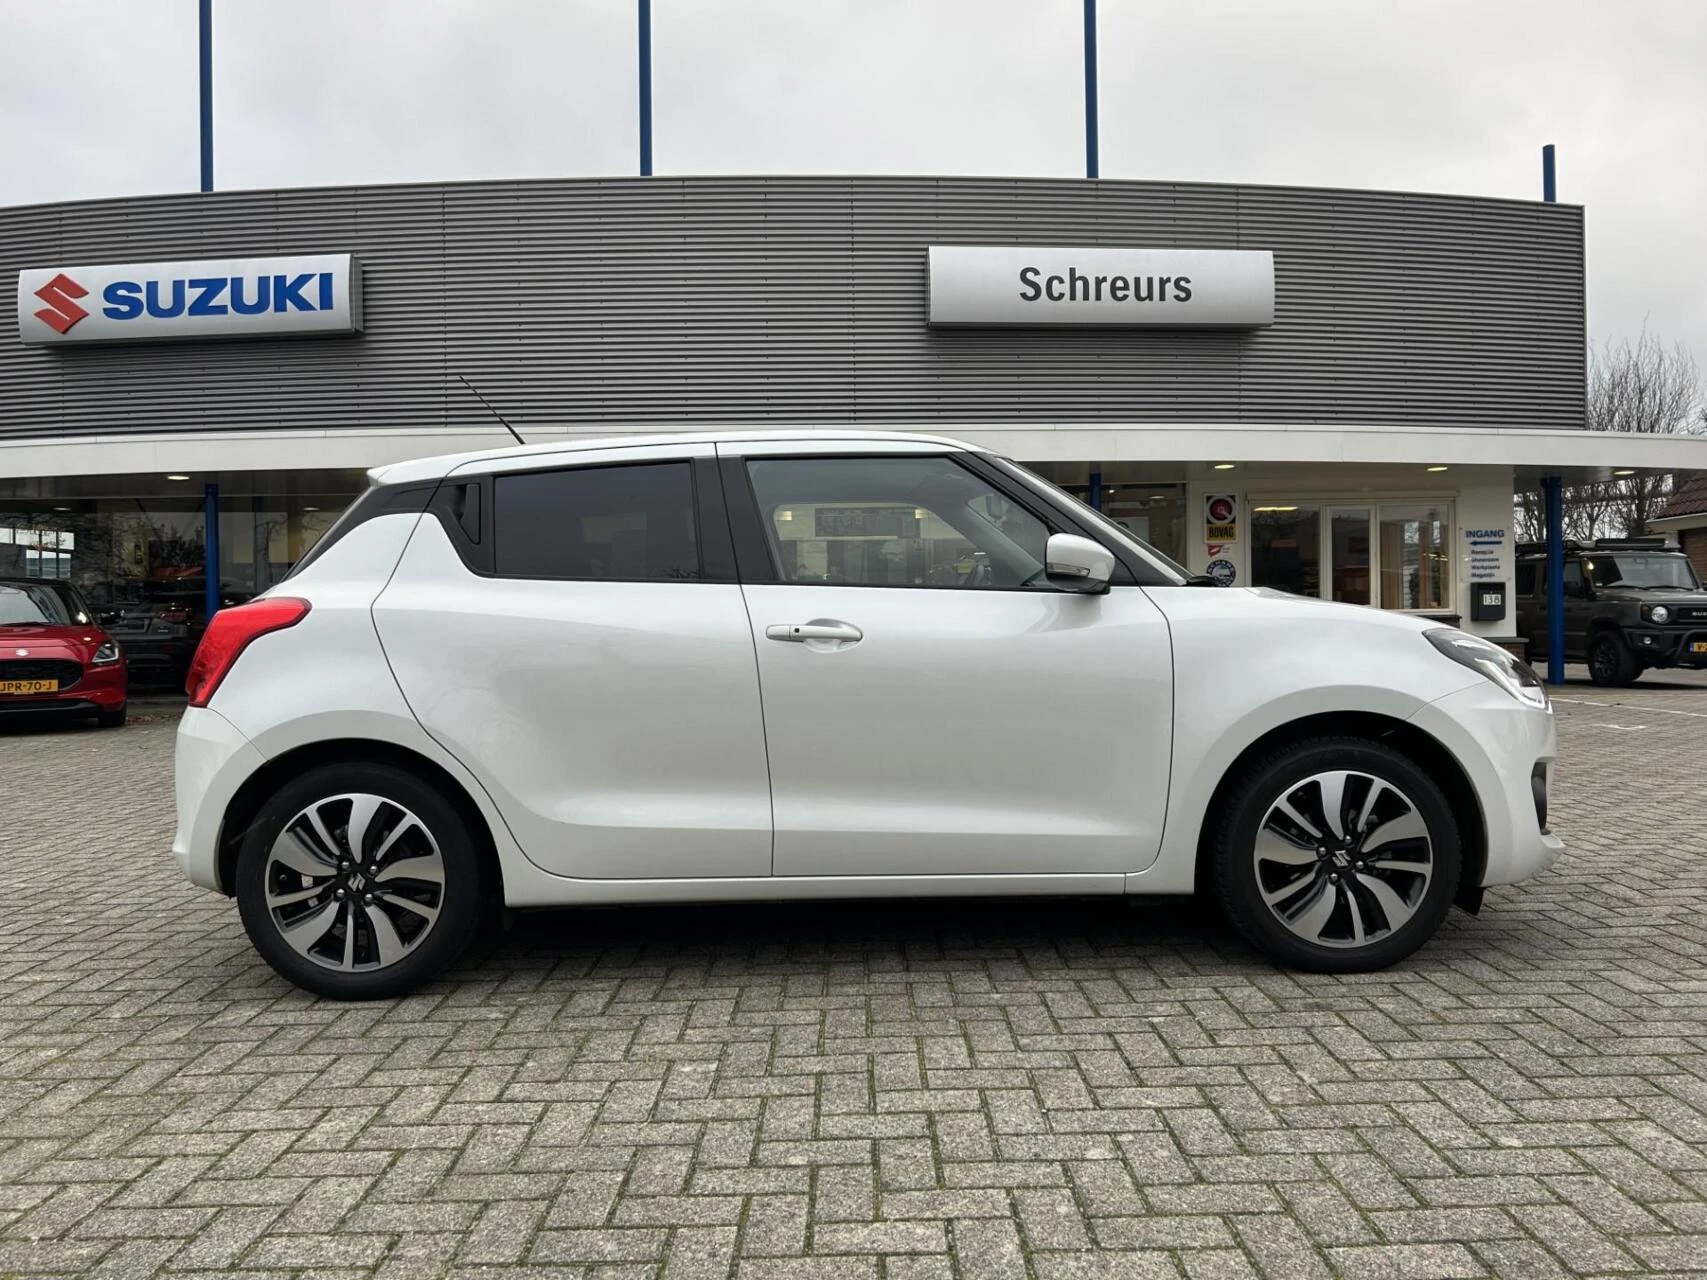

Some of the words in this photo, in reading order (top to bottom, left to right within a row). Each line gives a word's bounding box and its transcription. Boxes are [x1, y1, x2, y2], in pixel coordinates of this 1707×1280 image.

[1019, 267, 1192, 302] Schreurs
[102, 272, 333, 320] SUZUKI
[1209, 526, 1234, 538] BOVAG
[1465, 529, 1505, 538] INGANG
[1485, 595, 1500, 604] 138
